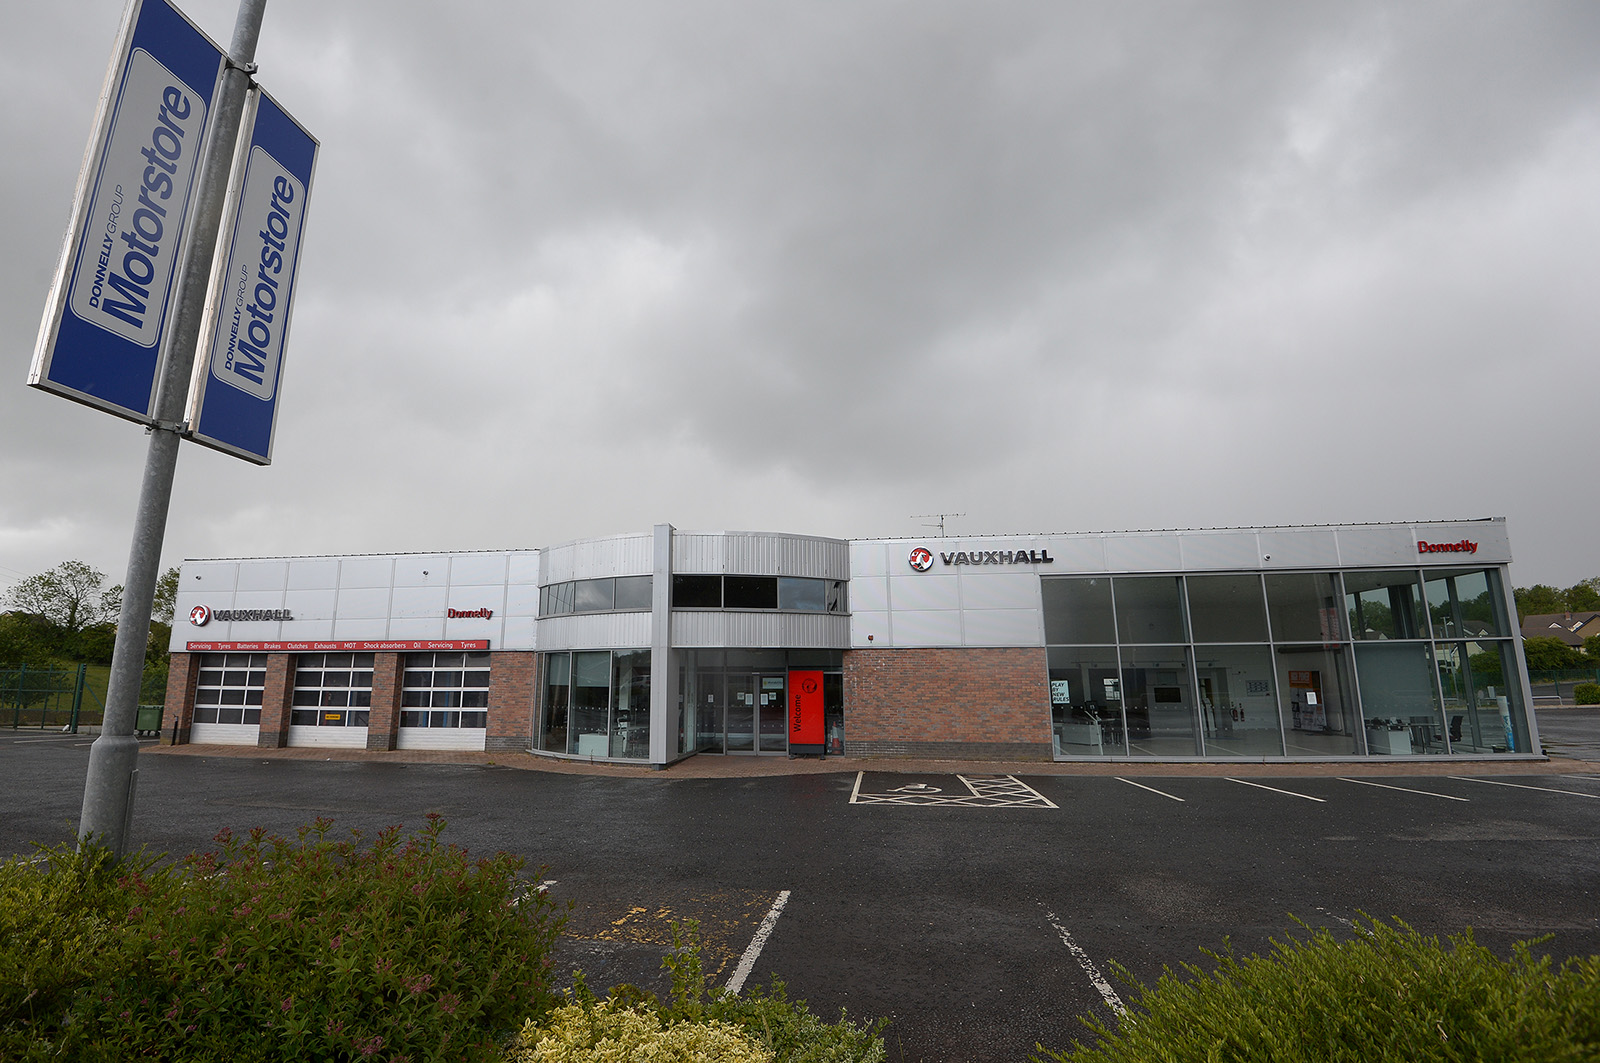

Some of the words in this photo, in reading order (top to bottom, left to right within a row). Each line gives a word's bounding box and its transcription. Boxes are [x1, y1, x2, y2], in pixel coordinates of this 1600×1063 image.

[101, 85, 191, 329] Motorstore
[89, 234, 112, 308] DONNELLY
[107, 184, 123, 234] GROUP
[233, 175, 295, 386] Motorstore
[224, 306, 241, 371] DONNELLY
[235, 264, 249, 307] GROUP
[940, 549, 1054, 565] VAUXHALL
[1417, 540, 1478, 554] Donnelly
[213, 609, 294, 621] VAUXHALL
[447, 608, 493, 620] Donnelly
